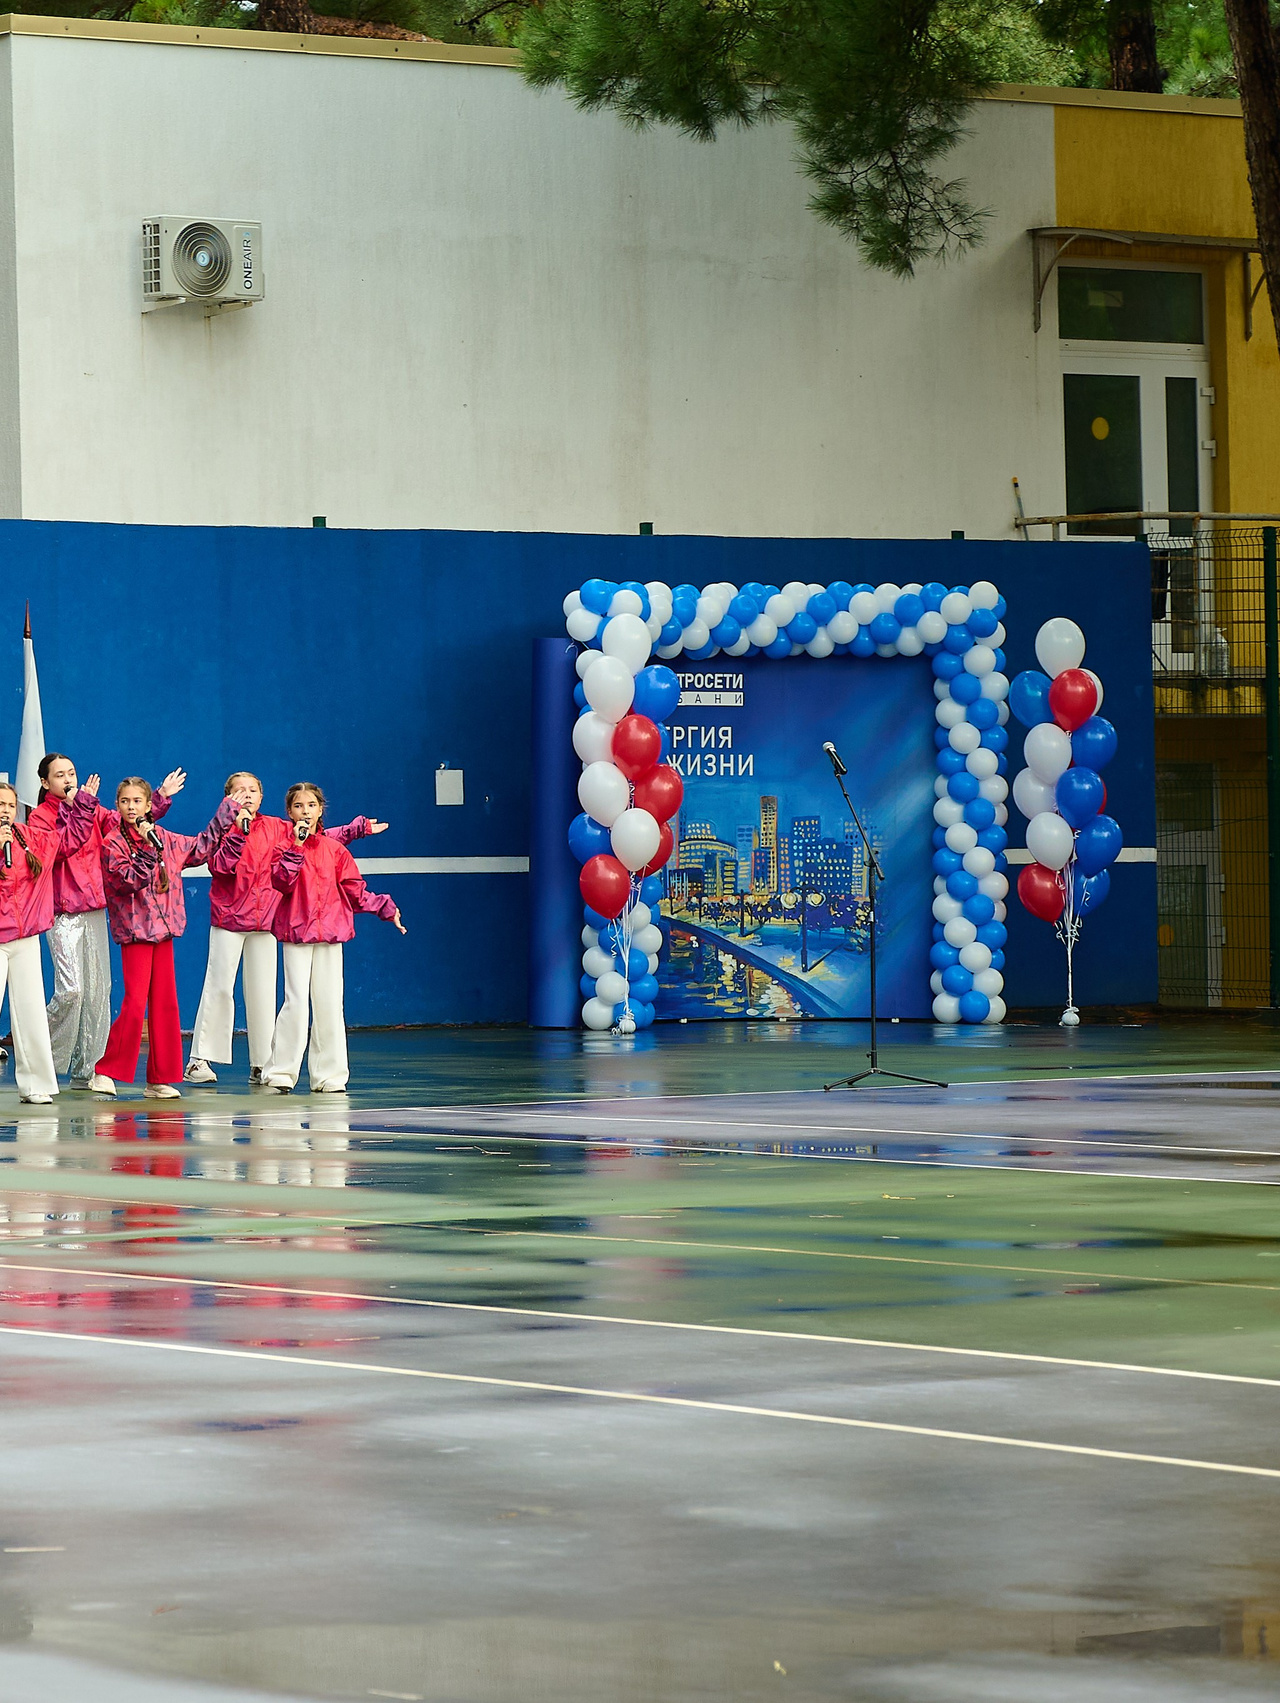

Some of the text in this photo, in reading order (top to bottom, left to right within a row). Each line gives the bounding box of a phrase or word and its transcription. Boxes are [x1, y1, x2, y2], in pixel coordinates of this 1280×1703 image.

[243, 239, 253, 290] ONEAIR
[676, 673, 743, 689] ТРОСЕТИ
[666, 726, 732, 749] РГИЯ
[666, 753, 754, 776] ЖИЗНИ
